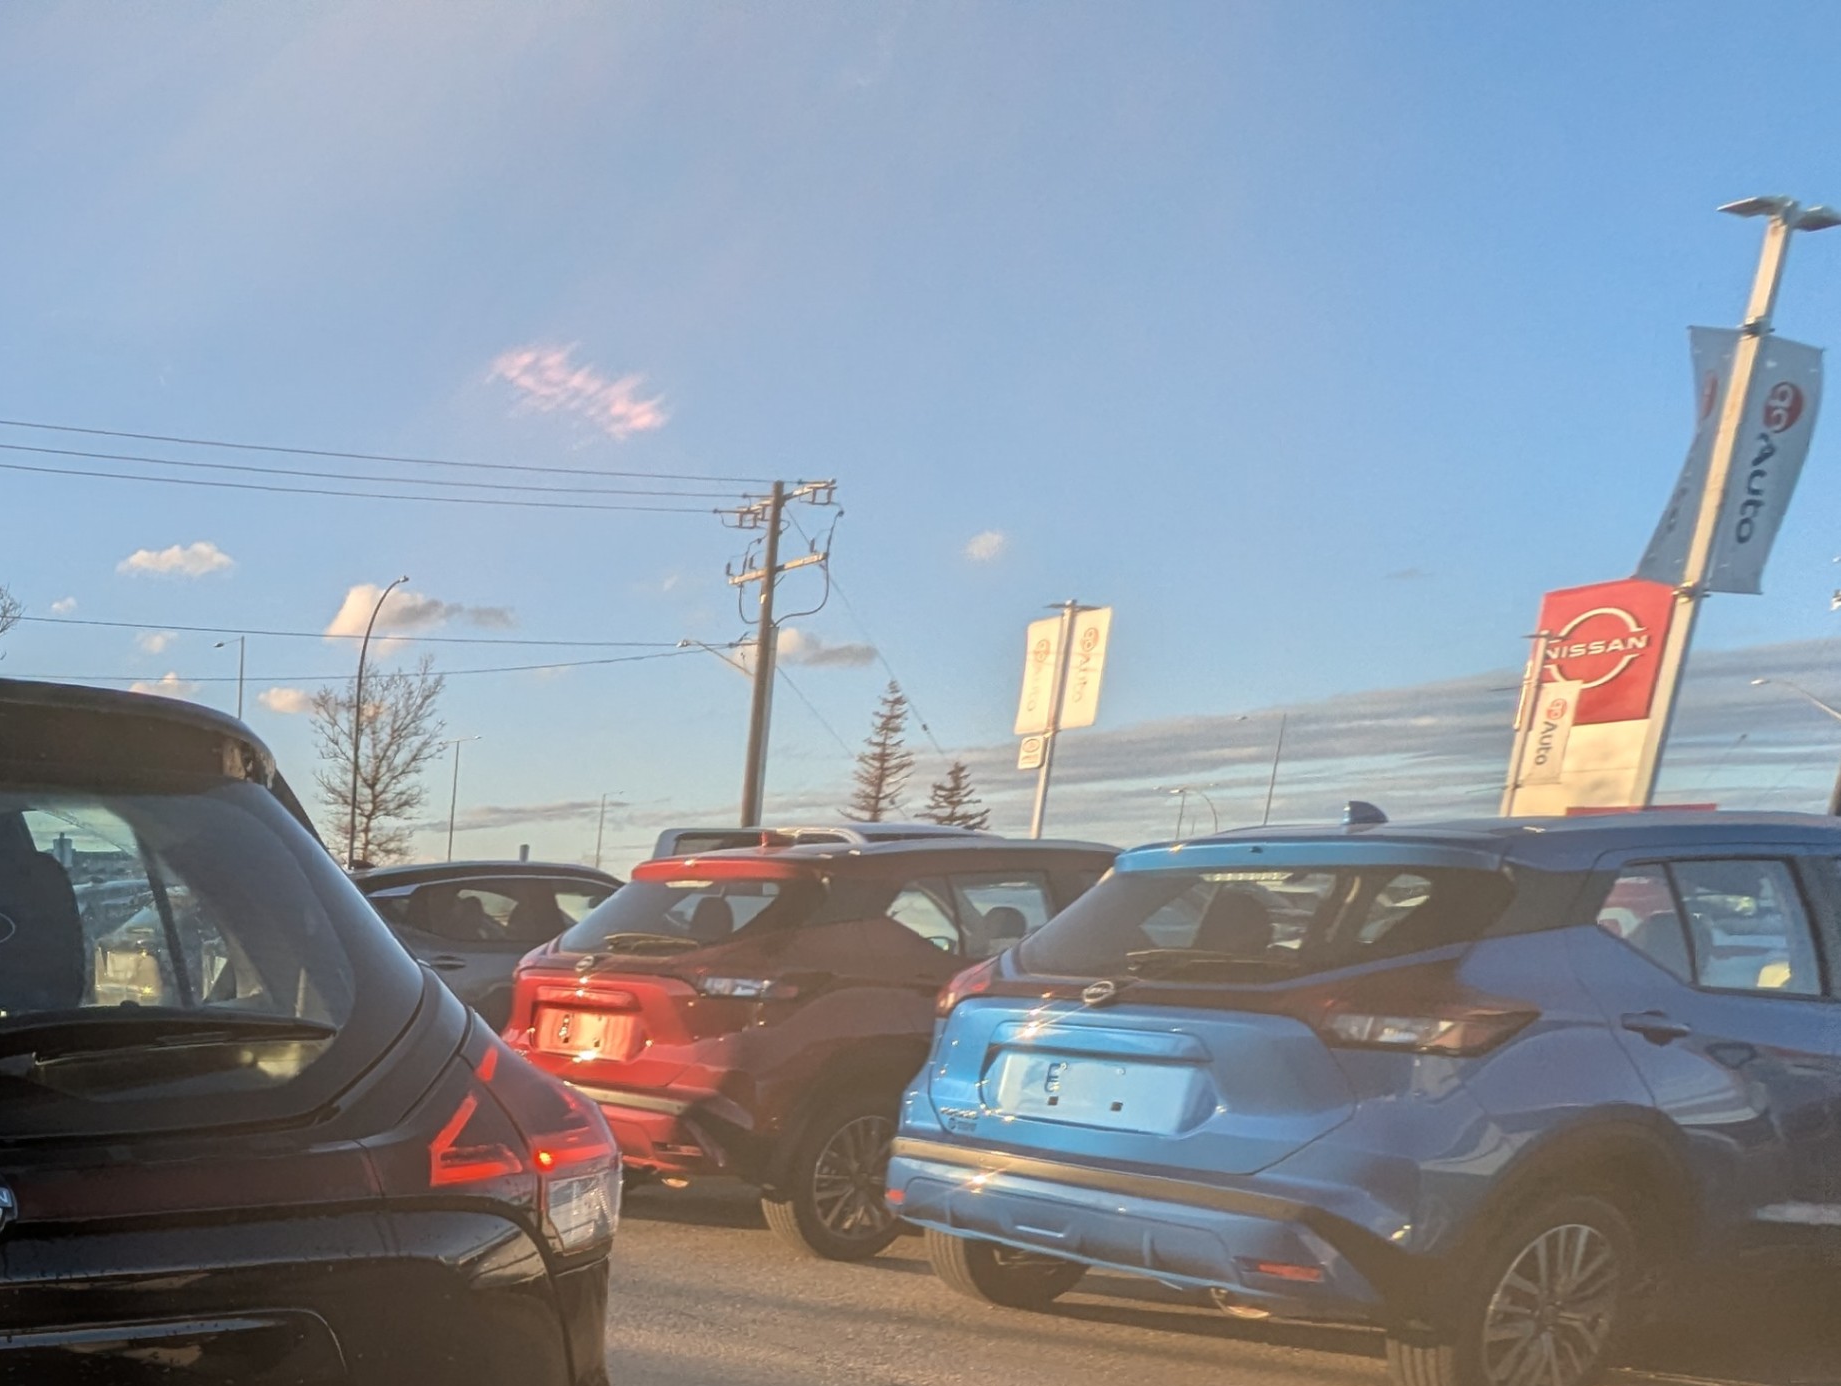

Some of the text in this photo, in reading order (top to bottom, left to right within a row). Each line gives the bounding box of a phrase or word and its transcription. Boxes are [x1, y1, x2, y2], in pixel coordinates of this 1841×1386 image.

[1735, 433, 1777, 544] Auto
[1546, 635, 1649, 660] NISSAN
[1535, 720, 1558, 766] Auto
